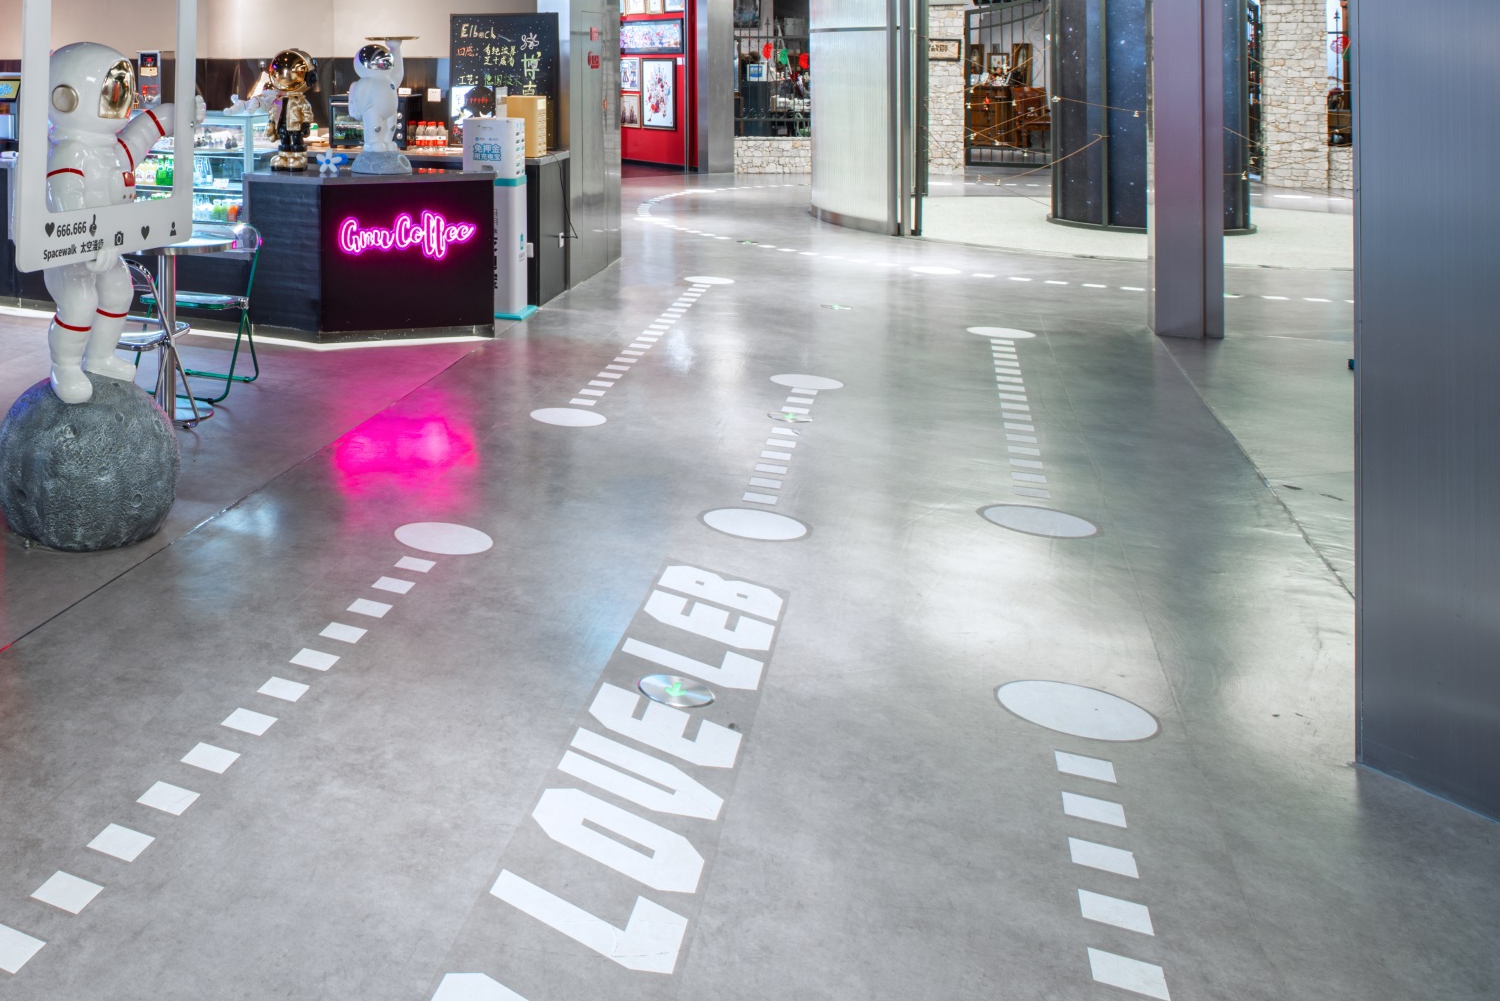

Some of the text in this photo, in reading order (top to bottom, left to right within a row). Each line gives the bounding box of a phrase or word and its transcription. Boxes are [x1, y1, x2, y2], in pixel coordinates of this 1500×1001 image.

[473, 143, 502, 153] 免押金
[473, 152, 502, 161] 用充电宝
[56, 221, 87, 238] 666.666
[395, 211, 476, 259] Coffee
[43, 243, 77, 262] Spacewalk
[489, 681, 743, 975] LOVE
